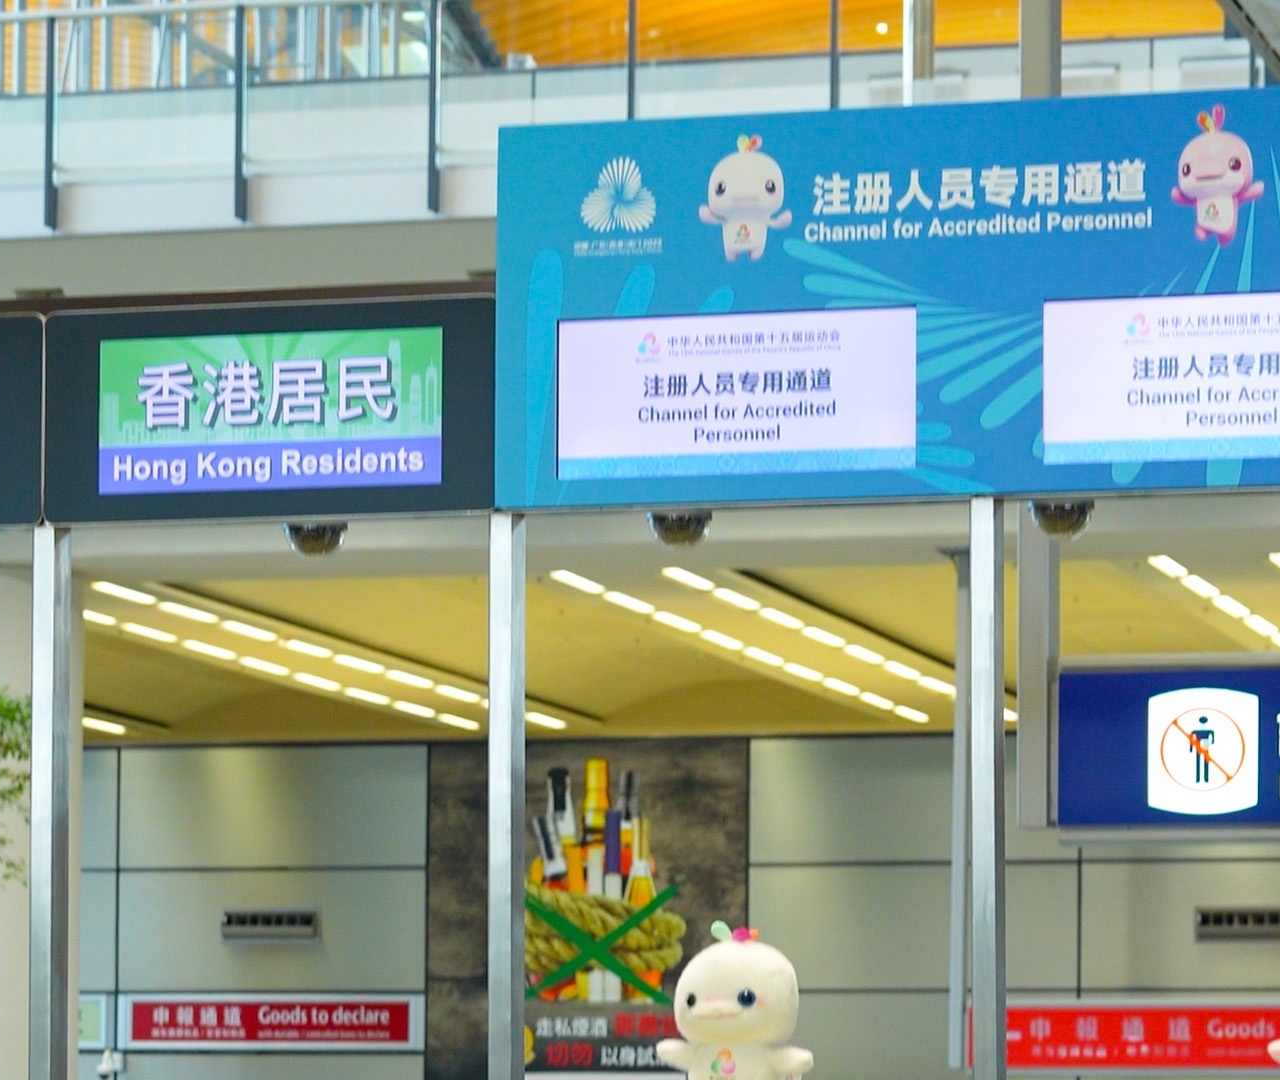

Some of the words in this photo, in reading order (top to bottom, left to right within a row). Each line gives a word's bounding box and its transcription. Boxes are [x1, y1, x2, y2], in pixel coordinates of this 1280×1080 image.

[813, 159, 1147, 216] 注册人员专用通道
[804, 220, 887, 244] Channel
[893, 218, 923, 238] for
[927, 212, 1041, 237] Accredited
[1046, 207, 1153, 233] Personnel
[138, 355, 395, 430] 香港居民
[643, 367, 832, 398] 注册人员专用通道
[1127, 386, 1201, 406] Channel
[1207, 385, 1231, 403] for
[638, 404, 708, 424] Channel
[714, 402, 738, 421] for
[743, 399, 837, 420] Accredited
[1186, 406, 1277, 427] Personnel
[693, 423, 781, 444] Personnel
[113, 454, 188, 485] Hong
[197, 450, 271, 483] Kong
[281, 446, 425, 477] Residents
[257, 1005, 308, 1026] Goods
[312, 1007, 329, 1026] to
[332, 1005, 391, 1026] declare
[1206, 1017, 1276, 1042] Goods
